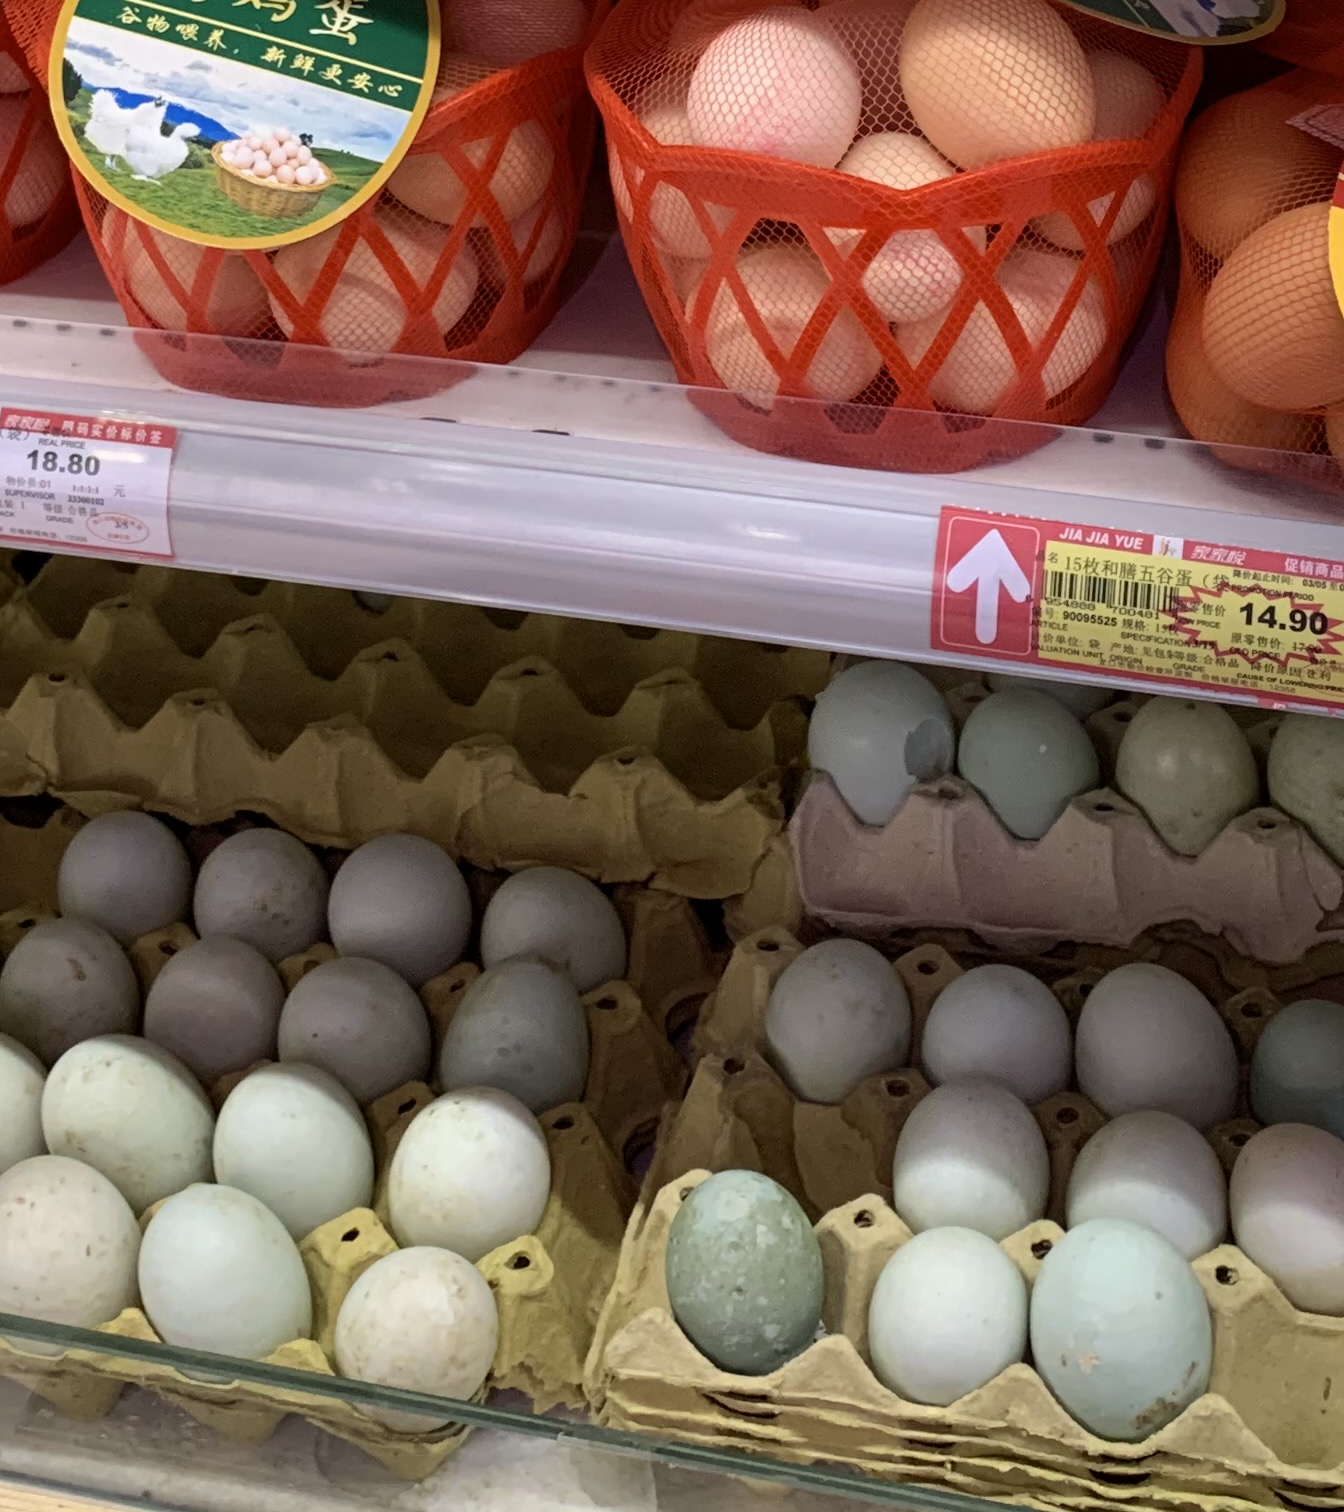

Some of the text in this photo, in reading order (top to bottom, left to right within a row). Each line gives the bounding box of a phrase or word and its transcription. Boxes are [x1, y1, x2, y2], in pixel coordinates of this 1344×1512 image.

[39, 438, 85, 449] REAL PRICE
[27, 449, 100, 476] 18.80
[5, 489, 55, 500] SUPERVISOR
[114, 485, 126, 498] 元
[1059, 528, 1082, 541] JIA
[1086, 531, 1109, 546] JIA
[1115, 535, 1143, 550] YUE
[1063, 610, 1117, 627] 90095525
[1239, 602, 1329, 635] 14.90
[1172, 663, 1206, 673] GRADE
[1236, 672, 1264, 682] CAUSE
